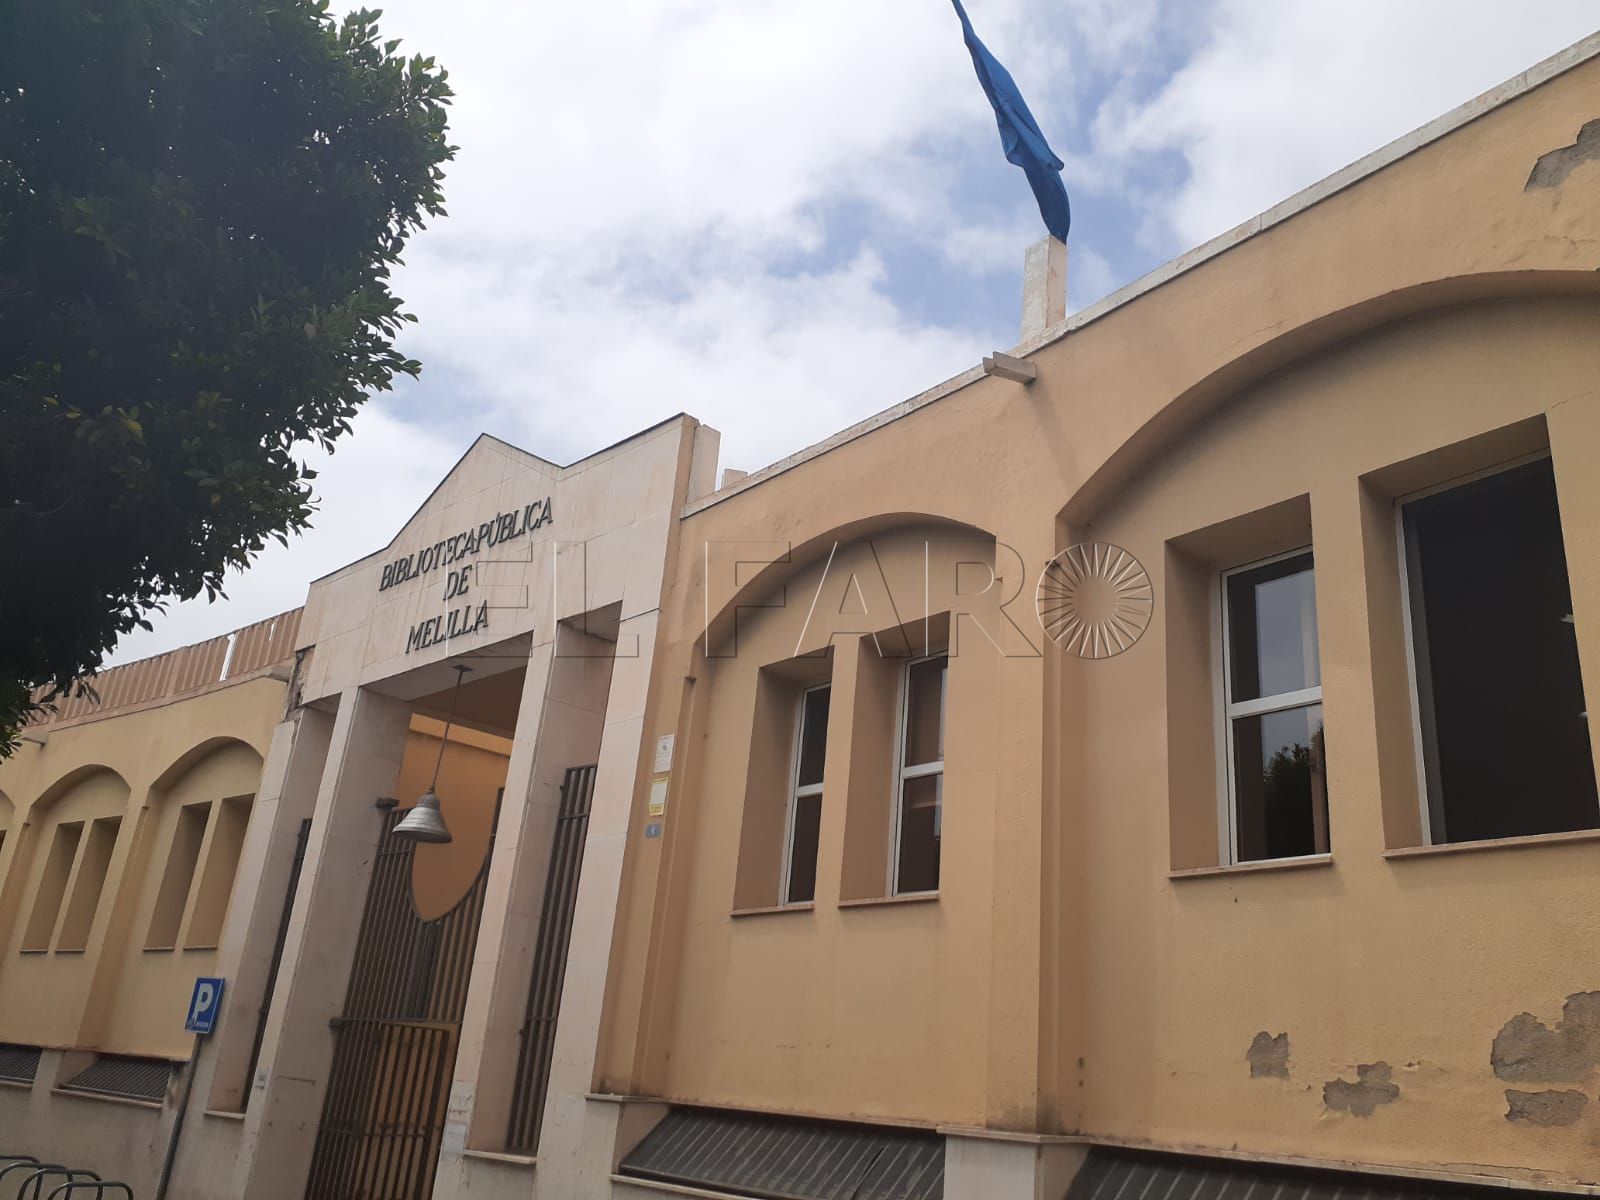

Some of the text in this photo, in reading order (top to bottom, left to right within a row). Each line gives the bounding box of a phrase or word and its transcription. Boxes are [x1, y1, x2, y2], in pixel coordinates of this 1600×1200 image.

[443, 564, 473, 601] DE
[405, 599, 489, 655] MELILLA
[192, 983, 214, 1024] P
